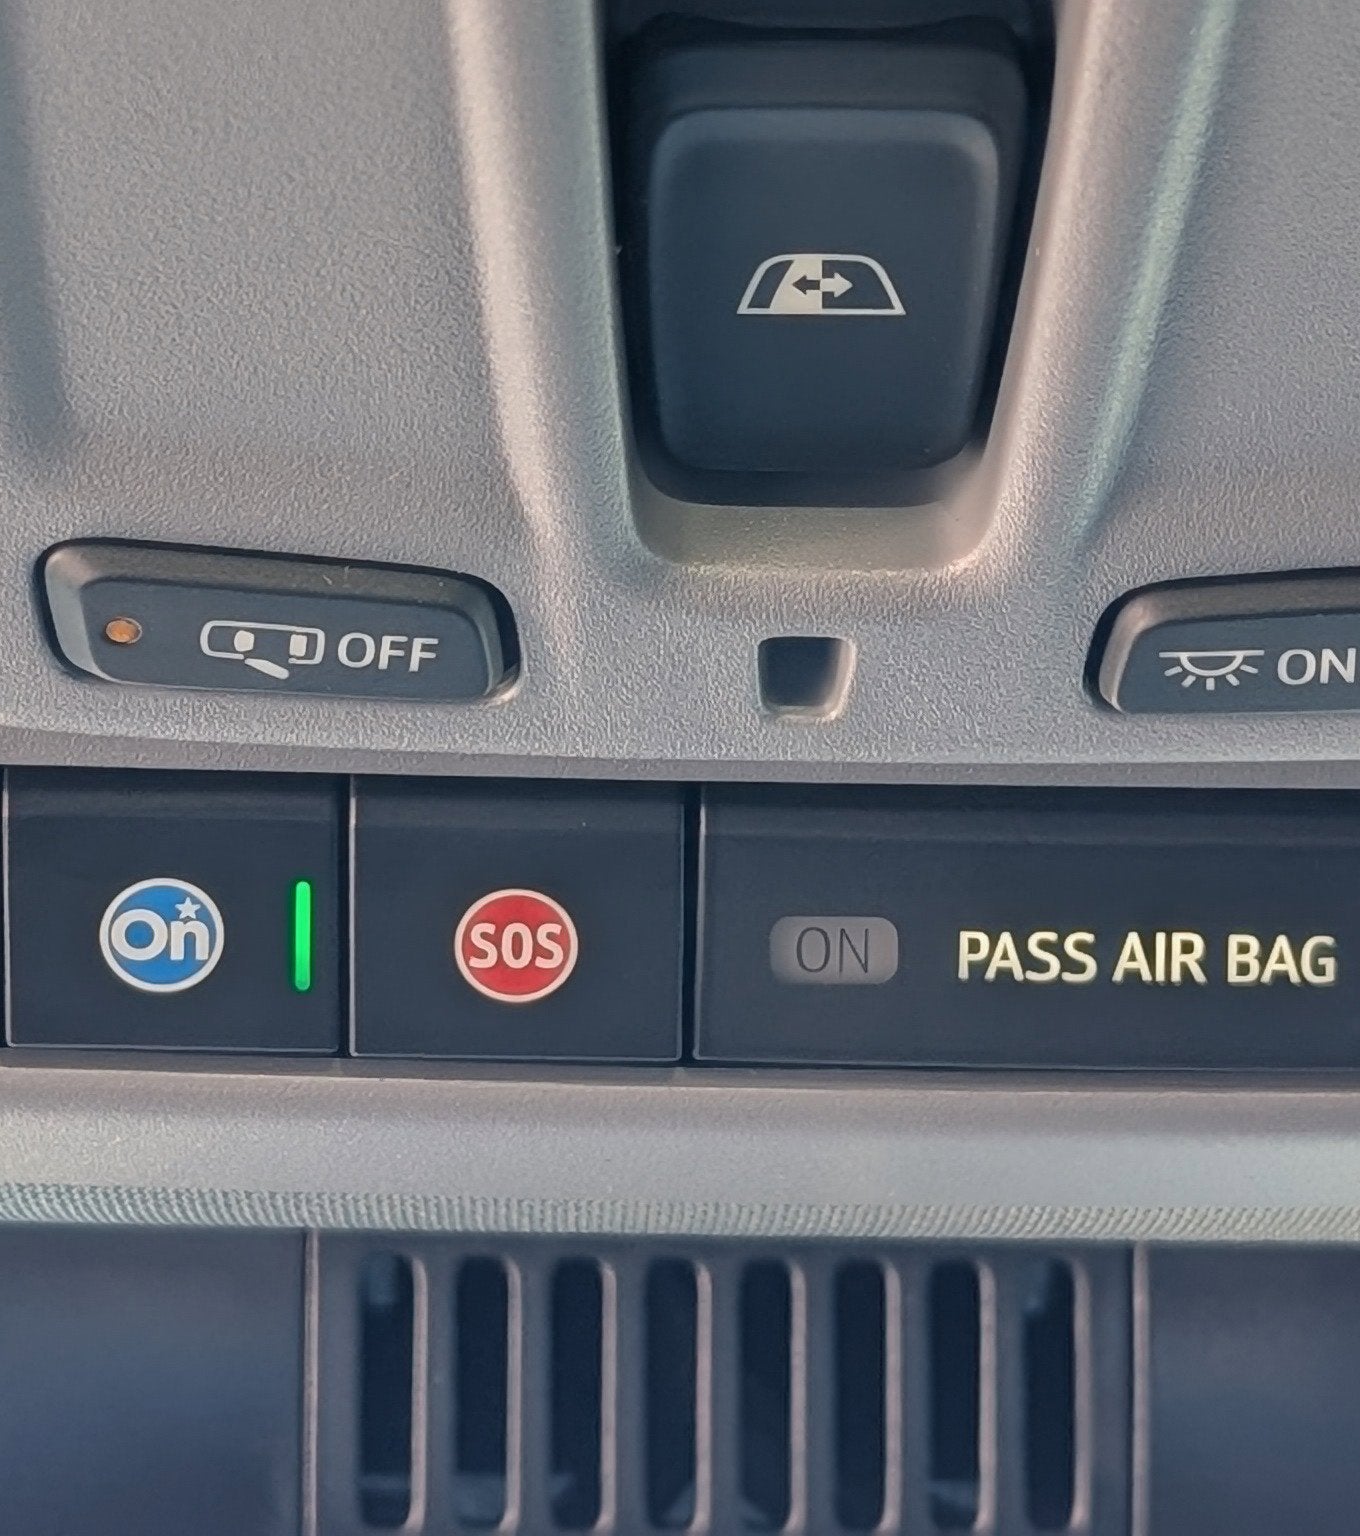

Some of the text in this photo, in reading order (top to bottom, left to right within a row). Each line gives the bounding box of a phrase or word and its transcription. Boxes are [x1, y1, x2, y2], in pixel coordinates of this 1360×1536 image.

[337, 632, 439, 672] OFF
[111, 907, 209, 961] On
[468, 922, 566, 971] SOS
[794, 926, 872, 975] ON
[957, 930, 1096, 983] PASS
[1112, 932, 1207, 984] AIR
[1227, 933, 1337, 985] BAG
